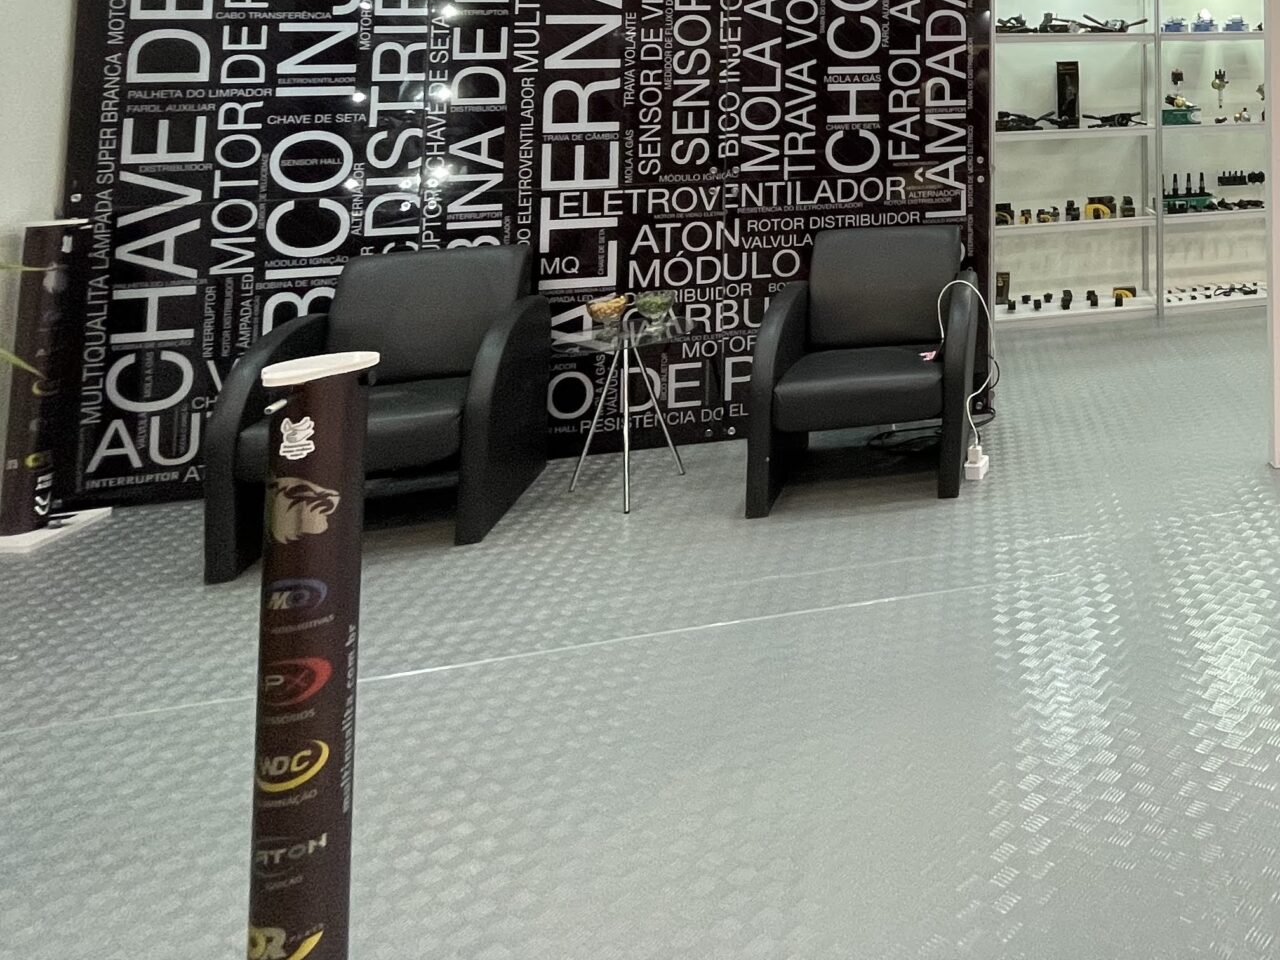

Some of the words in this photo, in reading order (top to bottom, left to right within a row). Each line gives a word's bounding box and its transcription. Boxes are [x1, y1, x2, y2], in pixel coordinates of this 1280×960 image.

[216, 11, 246, 20] CABO
[249, 10, 332, 20] TRANSFERÊNCIA
[665, 8, 673, 35] FLUXO
[220, 25, 268, 84] DE
[429, 16, 450, 63] SETA
[625, 12, 636, 66] VOLANTE
[641, 27, 663, 60] DE
[100, 52, 121, 123] BRANCA
[449, 27, 508, 106] DE
[664, 51, 672, 90] MEDIDOR
[824, 75, 851, 83] MOLA
[127, 90, 183, 99] PALHETA
[186, 89, 205, 98] DO
[209, 88, 272, 98] LIMPADOR
[624, 69, 635, 107] TRAVA
[740, 37, 782, 172] MOLA
[888, 35, 920, 160] FAROL
[267, 114, 312, 125] CHAVE
[314, 114, 331, 123] DE
[335, 113, 366, 123] SETA
[543, 134, 570, 142] TRAVA
[638, 70, 662, 175] SENSOR
[718, 92, 740, 158] BICO
[784, 59, 817, 180] TRAVA
[96, 127, 117, 185] SUPER
[139, 163, 213, 172] DISTRIBUIDOR
[519, 77, 535, 225] ELETROVENTILADOR
[209, 101, 264, 275] MOTOR
[559, 176, 907, 218] ELETROVENTILADOR
[908, 190, 961, 198] ALTERNADOR
[88, 189, 113, 269] LÂMPADA
[630, 218, 740, 255] ATON
[741, 233, 814, 249] VALVULA
[747, 219, 804, 233] ROTOR
[810, 211, 920, 229] DISTRIBUIDOR
[105, 116, 206, 413] CHAVE
[540, 256, 580, 275] MQ
[628, 249, 800, 289] MÓDULO
[202, 286, 216, 358] INTERRUPTOR
[80, 275, 110, 424] MULTIQUALITA
[85, 471, 179, 489] INTERRUPTOR
